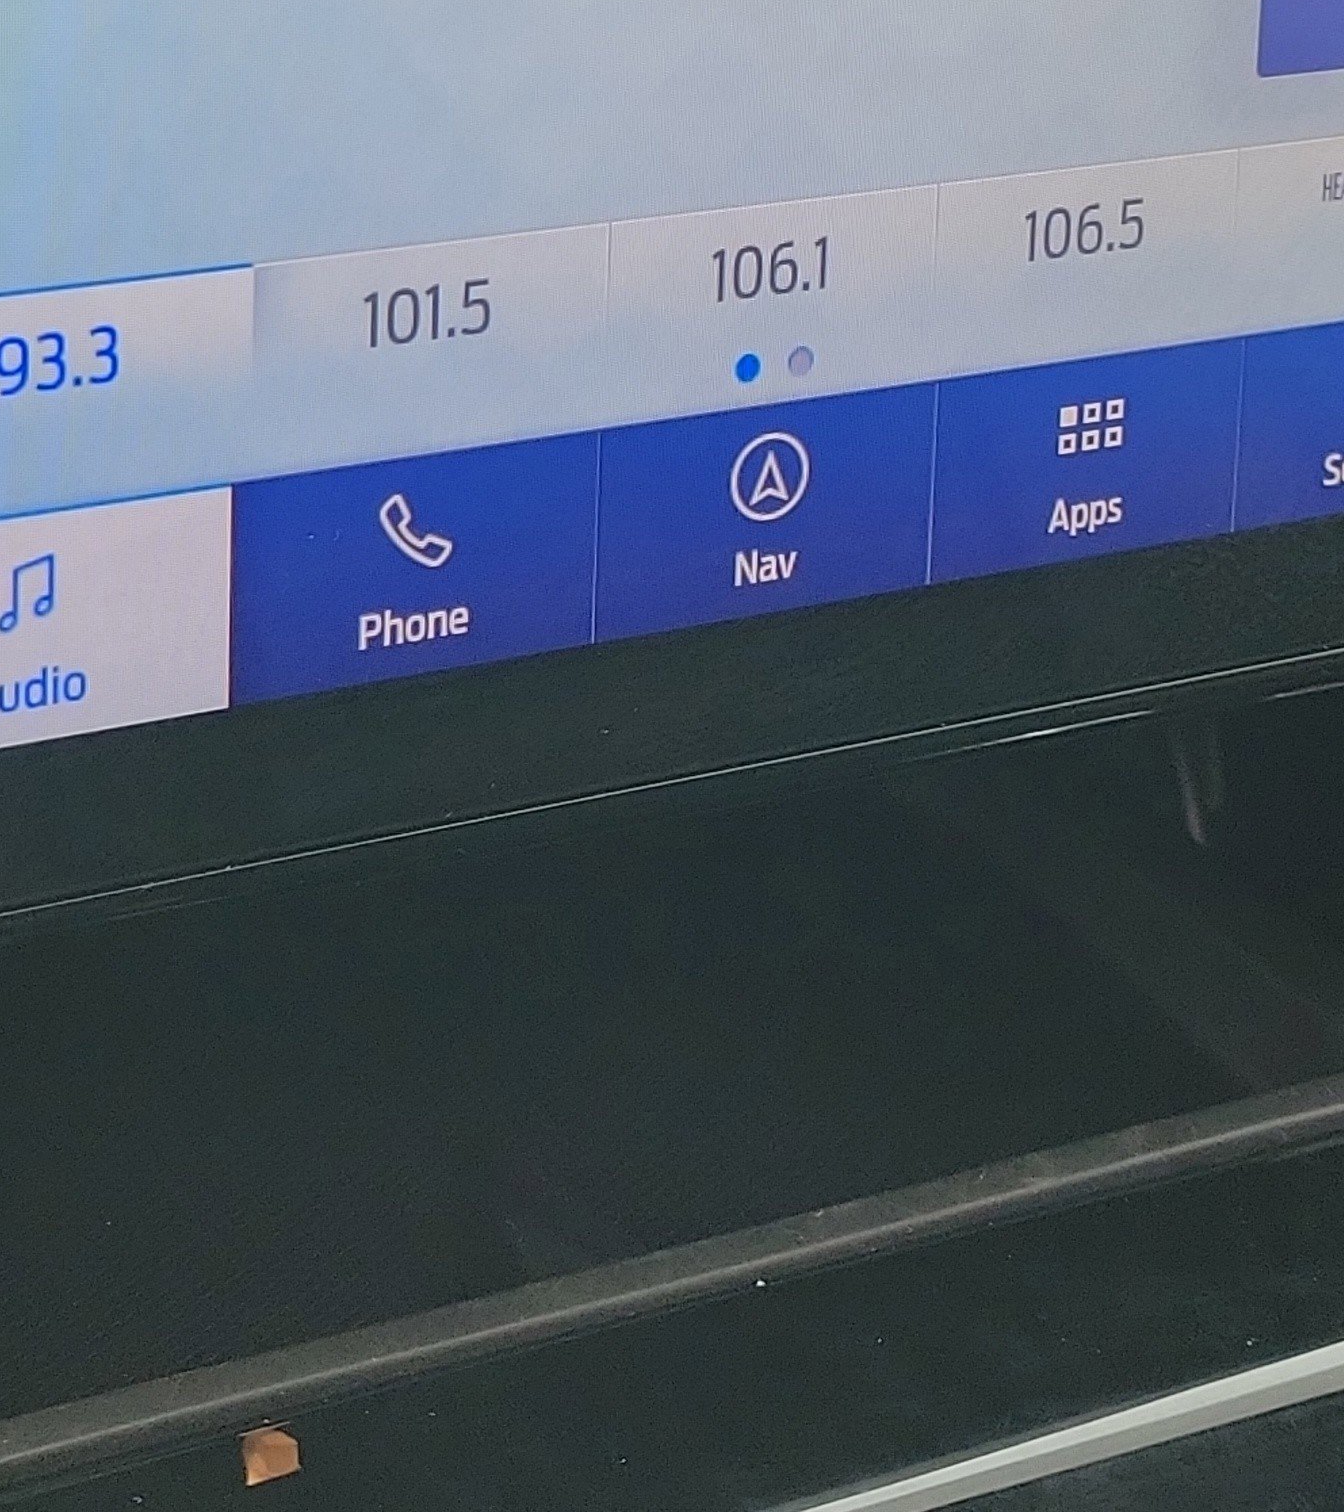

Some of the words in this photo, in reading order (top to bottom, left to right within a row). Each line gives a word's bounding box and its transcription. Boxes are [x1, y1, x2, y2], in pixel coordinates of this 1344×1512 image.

[1024, 198, 1146, 263] 106.5
[709, 235, 833, 303] 106.1
[362, 278, 492, 349] 101.5
[1048, 495, 1123, 538] Apps
[733, 549, 797, 587] Nav
[357, 603, 470, 651] Phone
